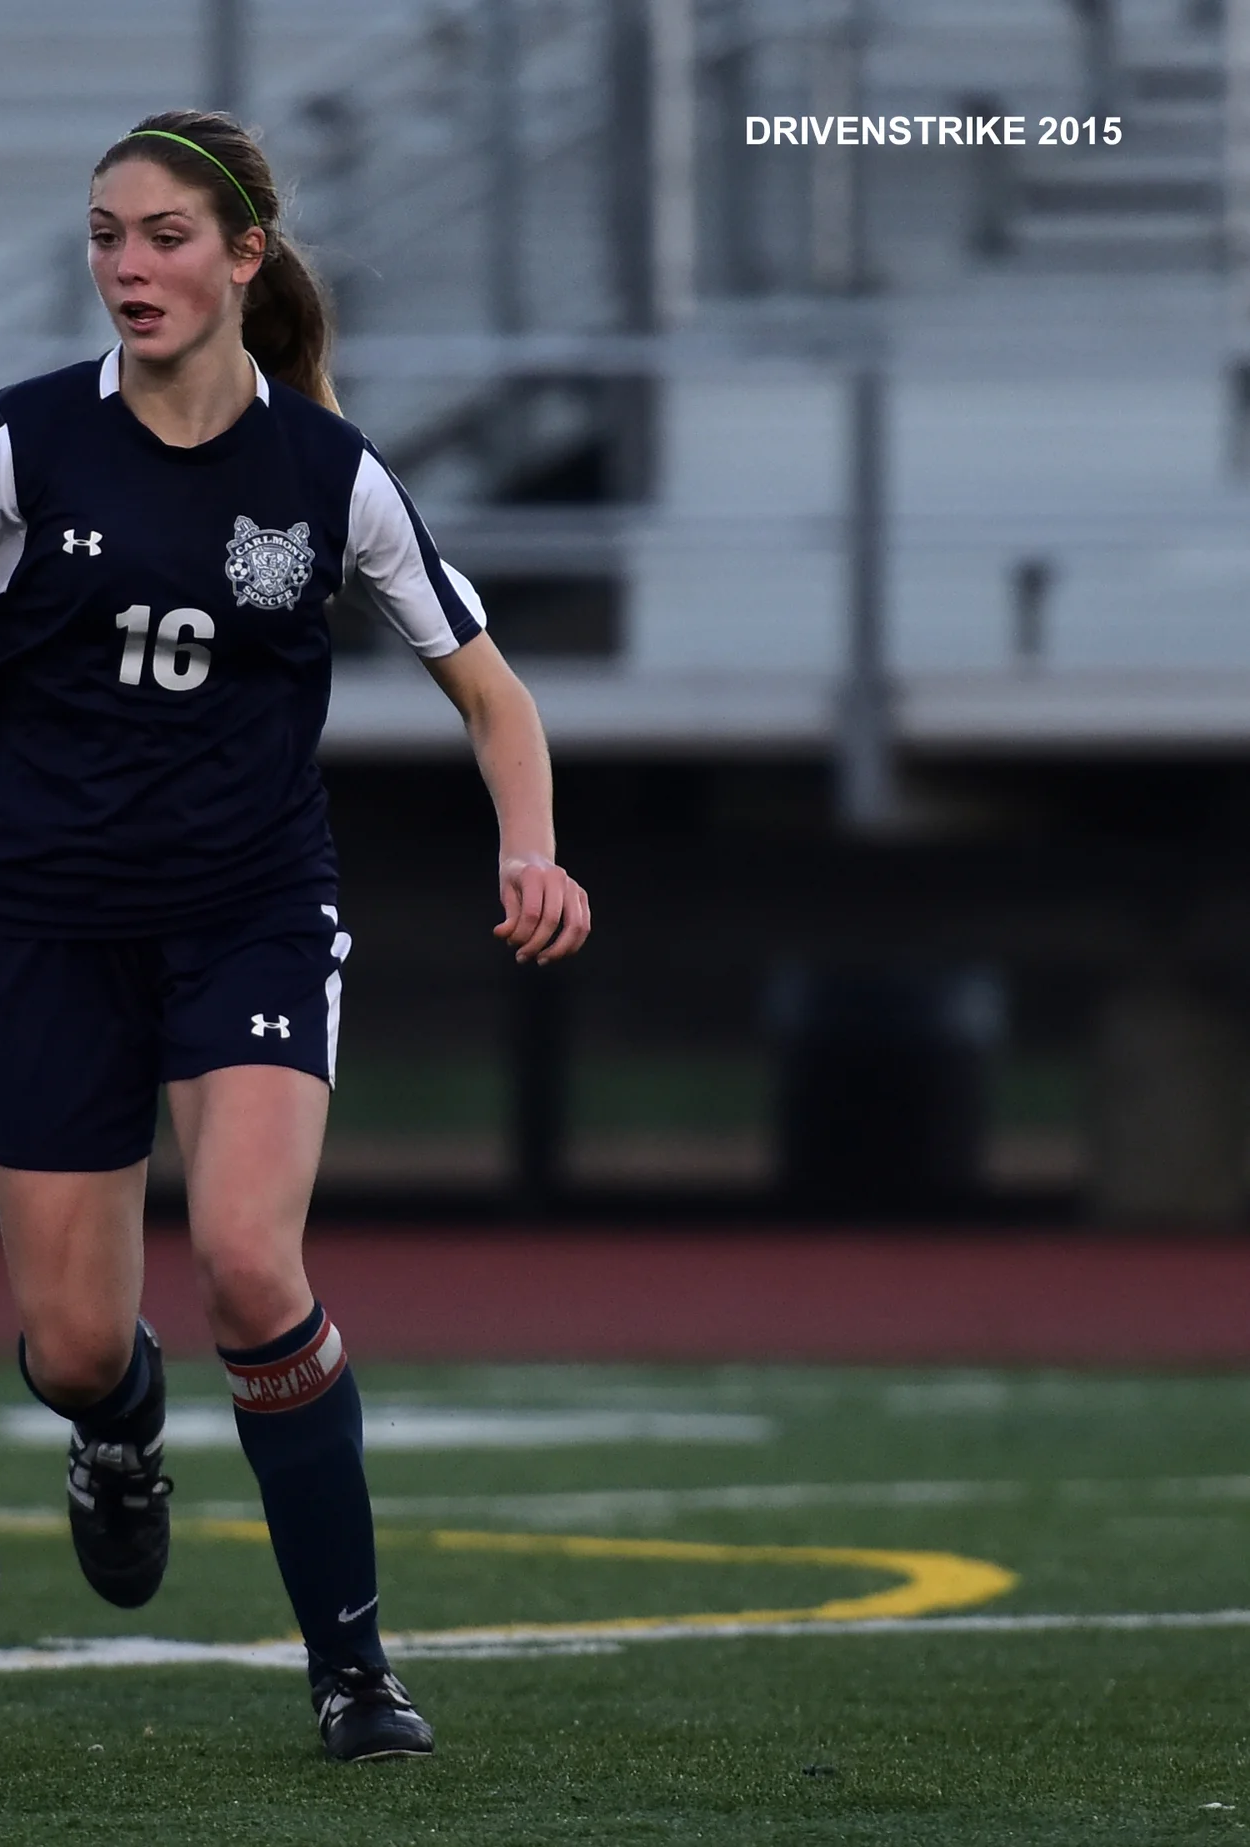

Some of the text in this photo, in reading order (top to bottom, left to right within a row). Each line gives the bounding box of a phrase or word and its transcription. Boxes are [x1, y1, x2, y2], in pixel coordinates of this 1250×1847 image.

[235, 535, 308, 562] CARLMONT
[243, 585, 294, 606] SOCCER
[115, 604, 215, 691] 16
[246, 1353, 326, 1402] CAPTAIN
